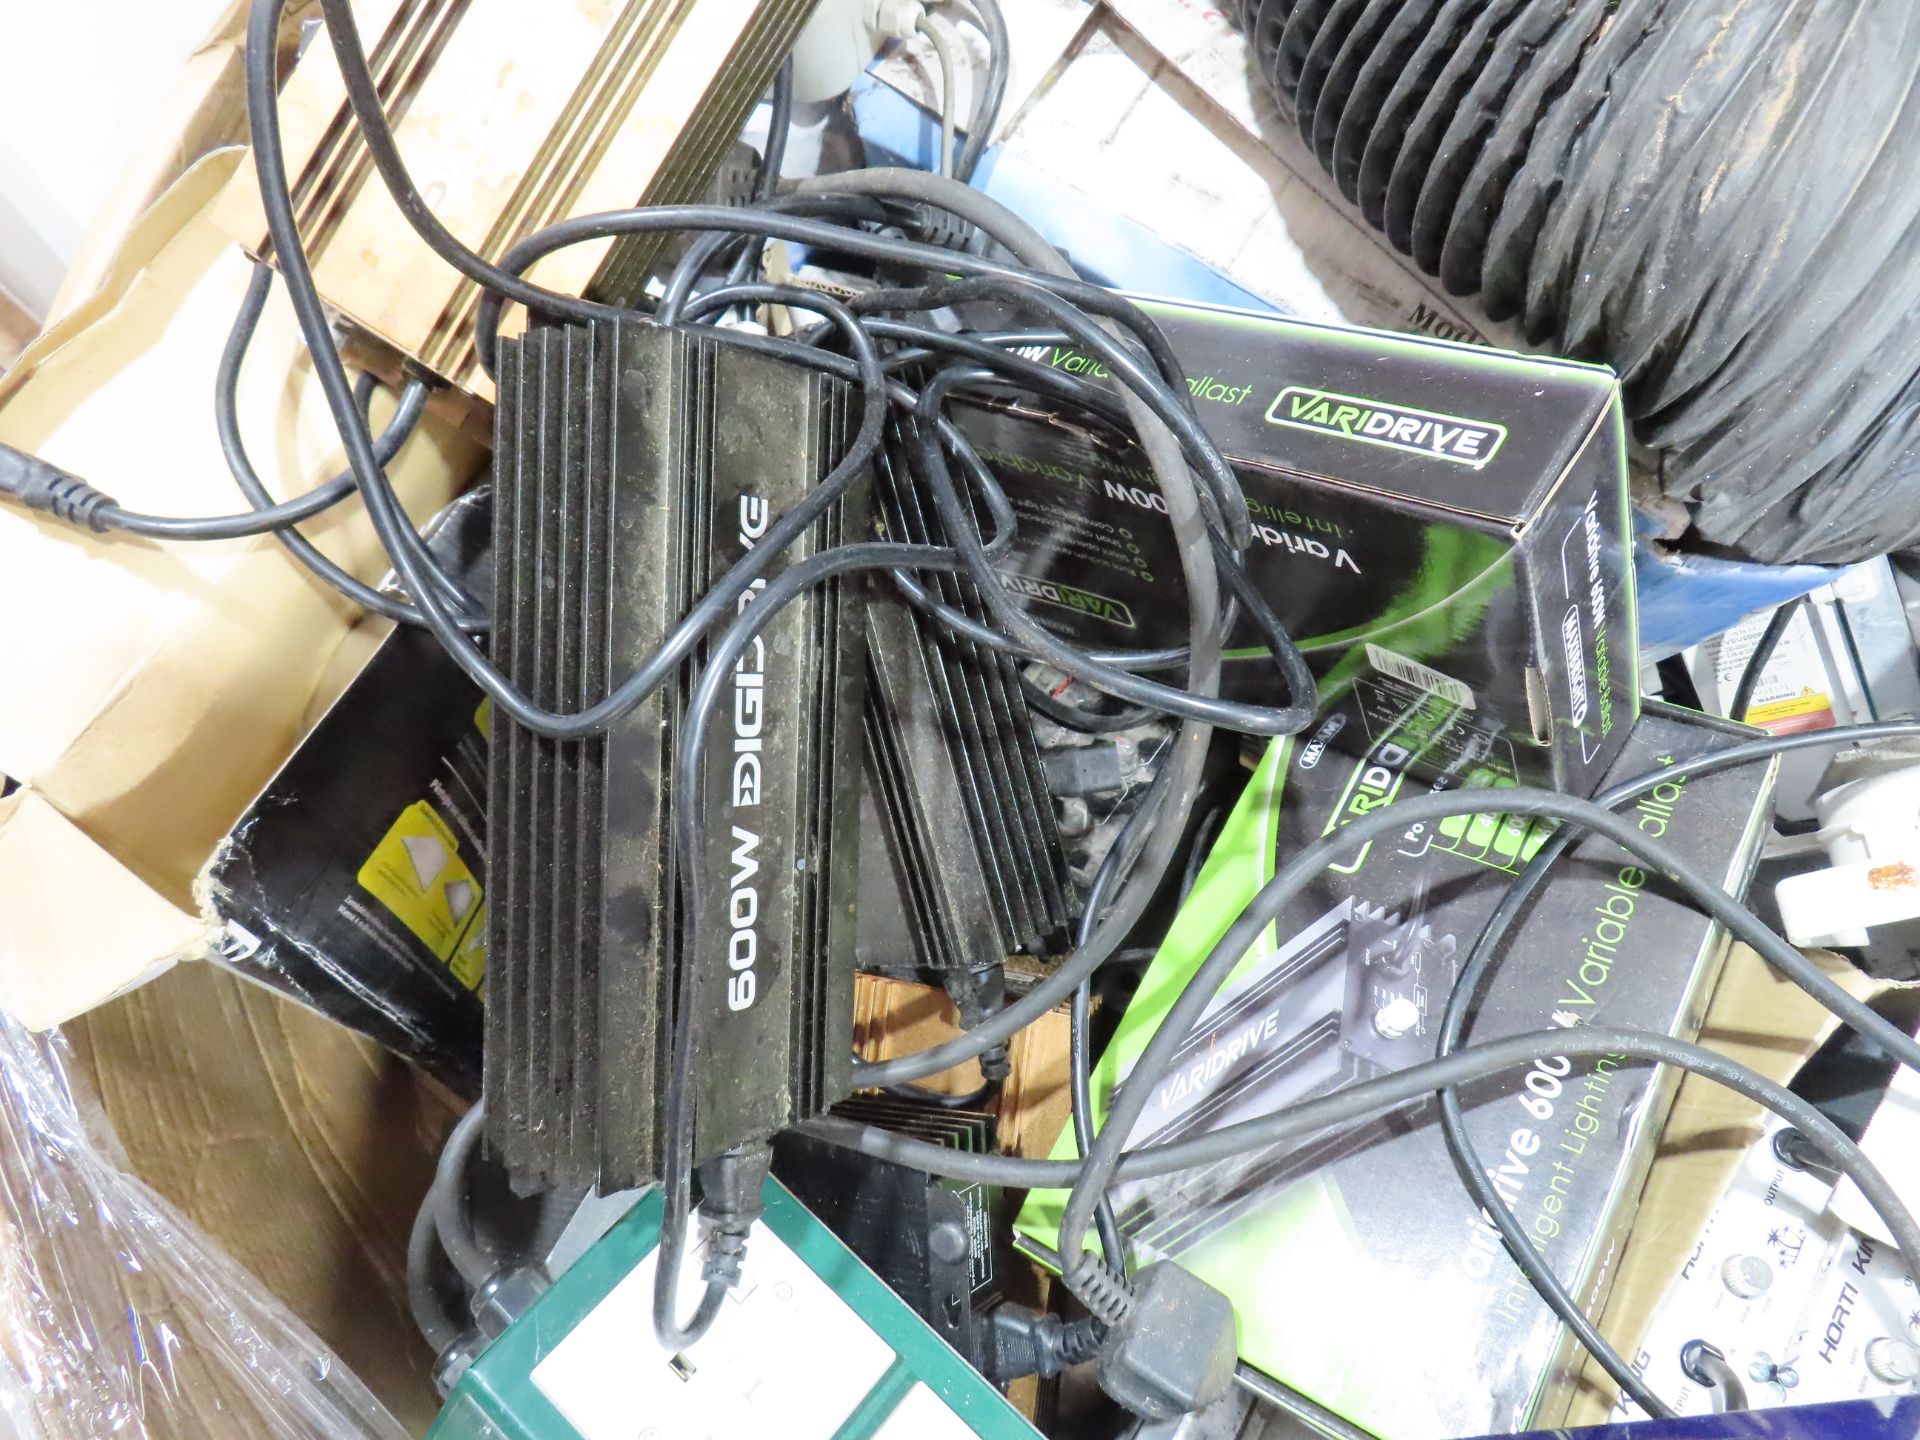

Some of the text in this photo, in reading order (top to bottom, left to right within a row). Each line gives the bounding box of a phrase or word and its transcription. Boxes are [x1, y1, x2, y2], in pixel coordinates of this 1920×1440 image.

[1185, 374, 1253, 405] allast
[1290, 393, 1488, 457] VARIDRIVE
[1103, 479, 1169, 515] 00W
[1244, 497, 1344, 540] Intellig
[1249, 521, 1363, 575] Varidr
[1584, 490, 1602, 583] Varidrive
[1001, 576, 1122, 621] VARIDRIV
[1591, 578, 1606, 630] 600W
[1596, 621, 1610, 693] Variable
[727, 826, 760, 1012] 600W
[1557, 866, 1647, 1005] Variable
[1160, 1008, 1281, 1113] VARIDRIVE
[1763, 1169, 1786, 1206] OUTPUT
[1818, 1281, 1858, 1364] HORTI
